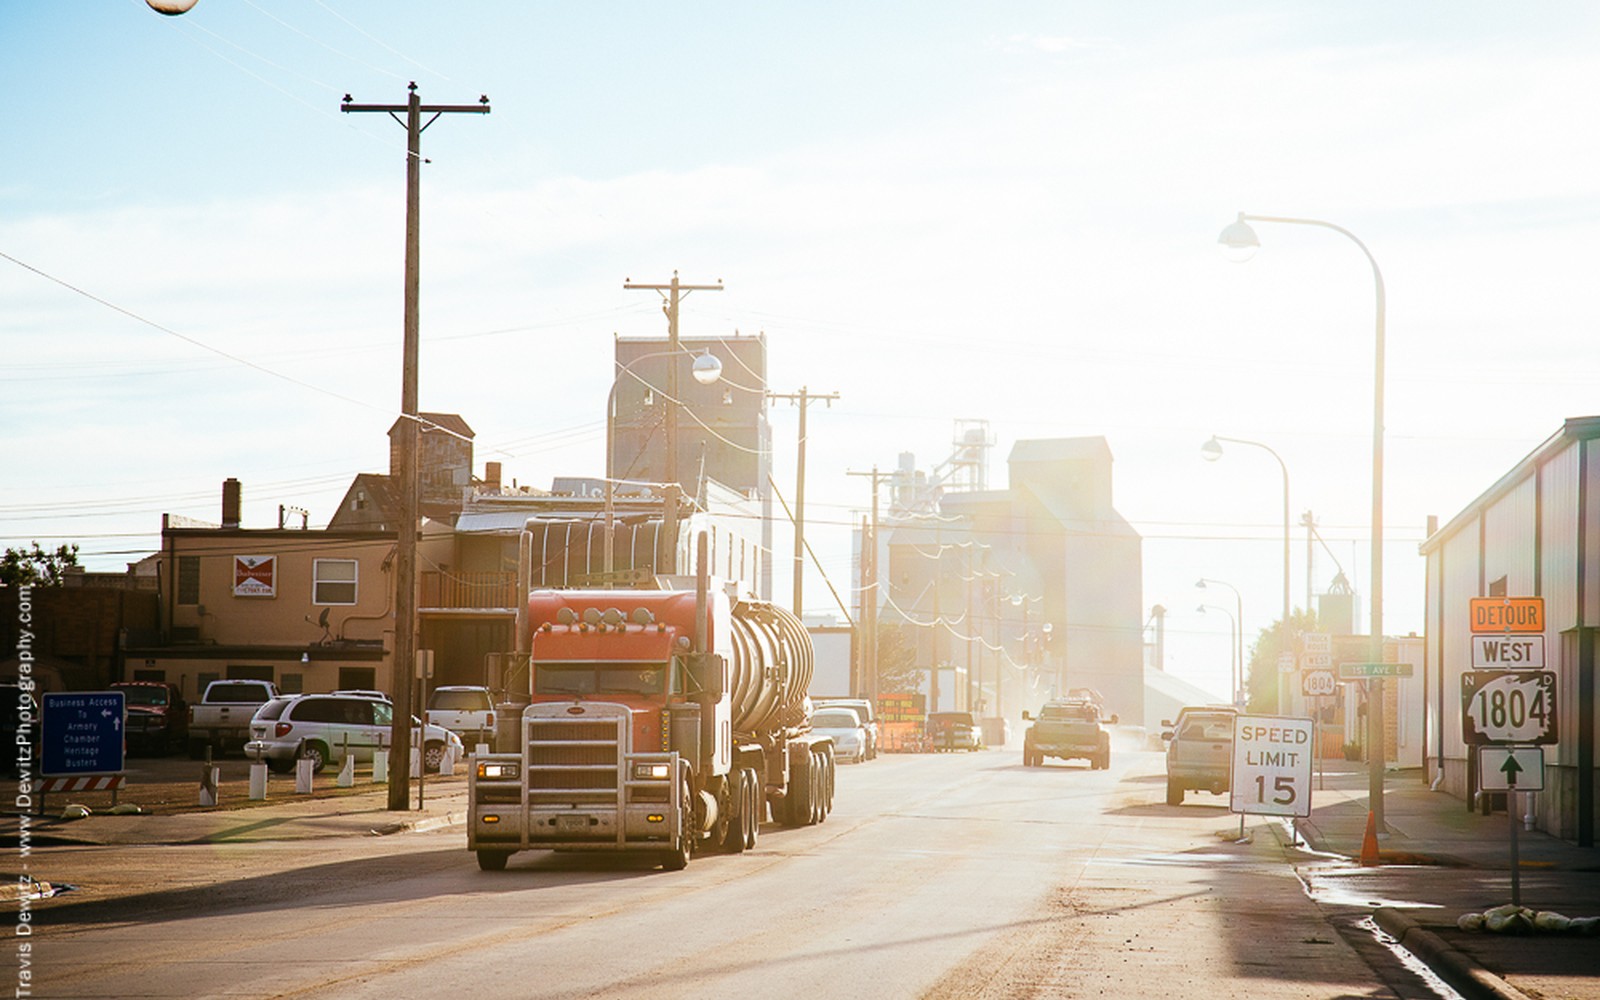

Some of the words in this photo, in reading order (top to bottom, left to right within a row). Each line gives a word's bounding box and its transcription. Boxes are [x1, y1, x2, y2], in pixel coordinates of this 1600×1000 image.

[1477, 605, 1537, 625] DETOUR
[1482, 641, 1533, 662] WEST
[1308, 656, 1329, 665] WEST
[1352, 666, 1367, 674] 1ST
[1372, 666, 1391, 674] AVE
[1396, 666, 1402, 674] E
[1308, 676, 1333, 690] 1804
[1464, 676, 1475, 686] N
[1543, 676, 1553, 686] D
[49, 699, 85, 708] Business
[89, 698, 117, 707] Access
[1478, 689, 1546, 728] 1804
[78, 709, 87, 719] To
[67, 723, 98, 732] Armory
[64, 735, 100, 744] Chamber
[1241, 726, 1308, 744] SPEED
[64, 747, 100, 757] Heritage
[1247, 751, 1299, 767] LIMIT
[1255, 775, 1296, 805] 15
